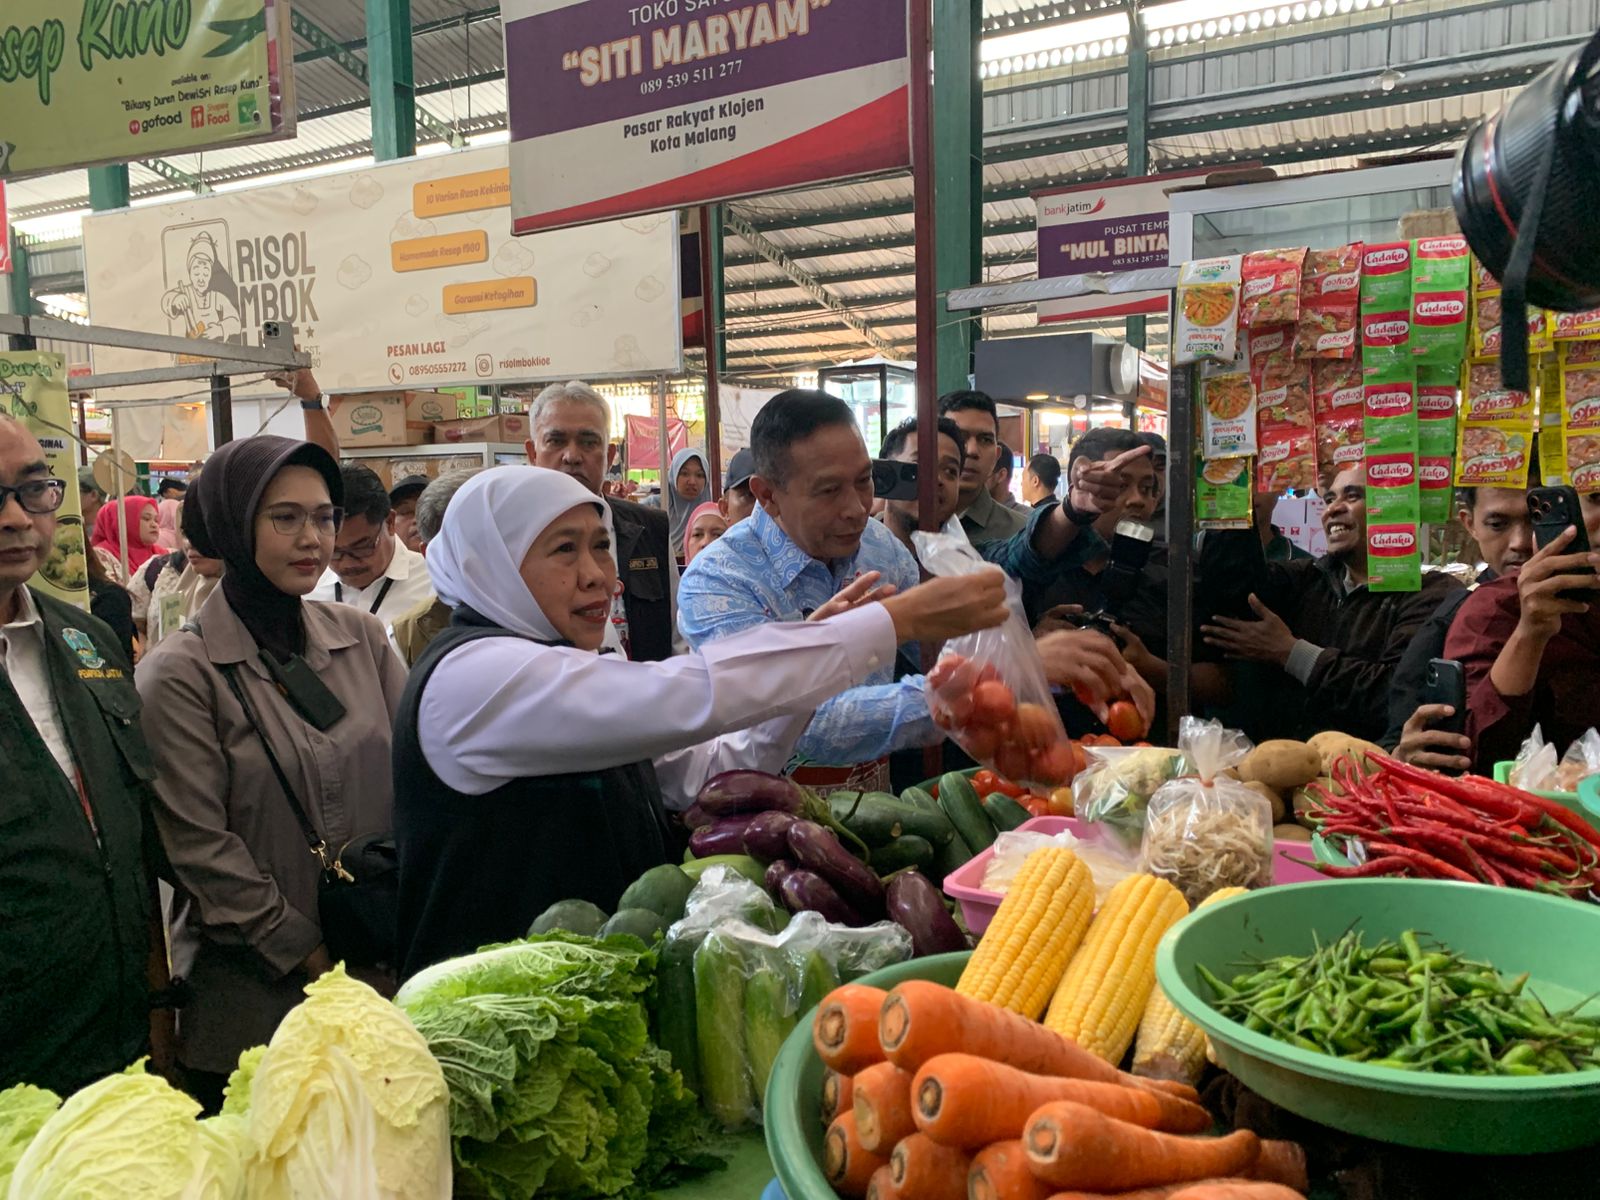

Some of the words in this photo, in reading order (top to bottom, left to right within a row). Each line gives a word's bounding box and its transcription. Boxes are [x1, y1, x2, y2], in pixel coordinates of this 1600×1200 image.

[628, 0, 678, 26] TOKO
[77, 0, 191, 71] Kuno
[640, 78, 663, 96] 089
[666, 71, 689, 90] 539
[692, 65, 714, 85] 511
[719, 59, 743, 78] 277
[153, 95, 176, 106] Duren
[142, 111, 183, 133] gofood
[207, 112, 231, 126] Food
[623, 117, 663, 139] Pasar
[666, 106, 716, 132] Rakyat
[719, 96, 765, 122] Klojen
[650, 136, 681, 154] Kota
[685, 122, 737, 150] Malang
[1044, 201, 1092, 216] bankjatim
[1104, 223, 1138, 236] PUSAT
[1140, 220, 1169, 232] TEMP
[235, 231, 316, 283] RISOL
[1112, 257, 1126, 267] 083
[1127, 256, 1140, 265] 834
[1141, 254, 1154, 263] 287
[1366, 251, 1407, 265] Ladaku
[239, 276, 320, 328] MBOK
[1418, 302, 1460, 315] Ladaku
[1368, 321, 1408, 336] Ladaku
[387, 343, 419, 358] PESAN
[420, 341, 446, 355] LAGI
[1369, 393, 1410, 407] Ladaku
[1418, 396, 1450, 409] adaku
[1371, 463, 1412, 478] Ladaku
[1372, 533, 1413, 548] Ladaku
